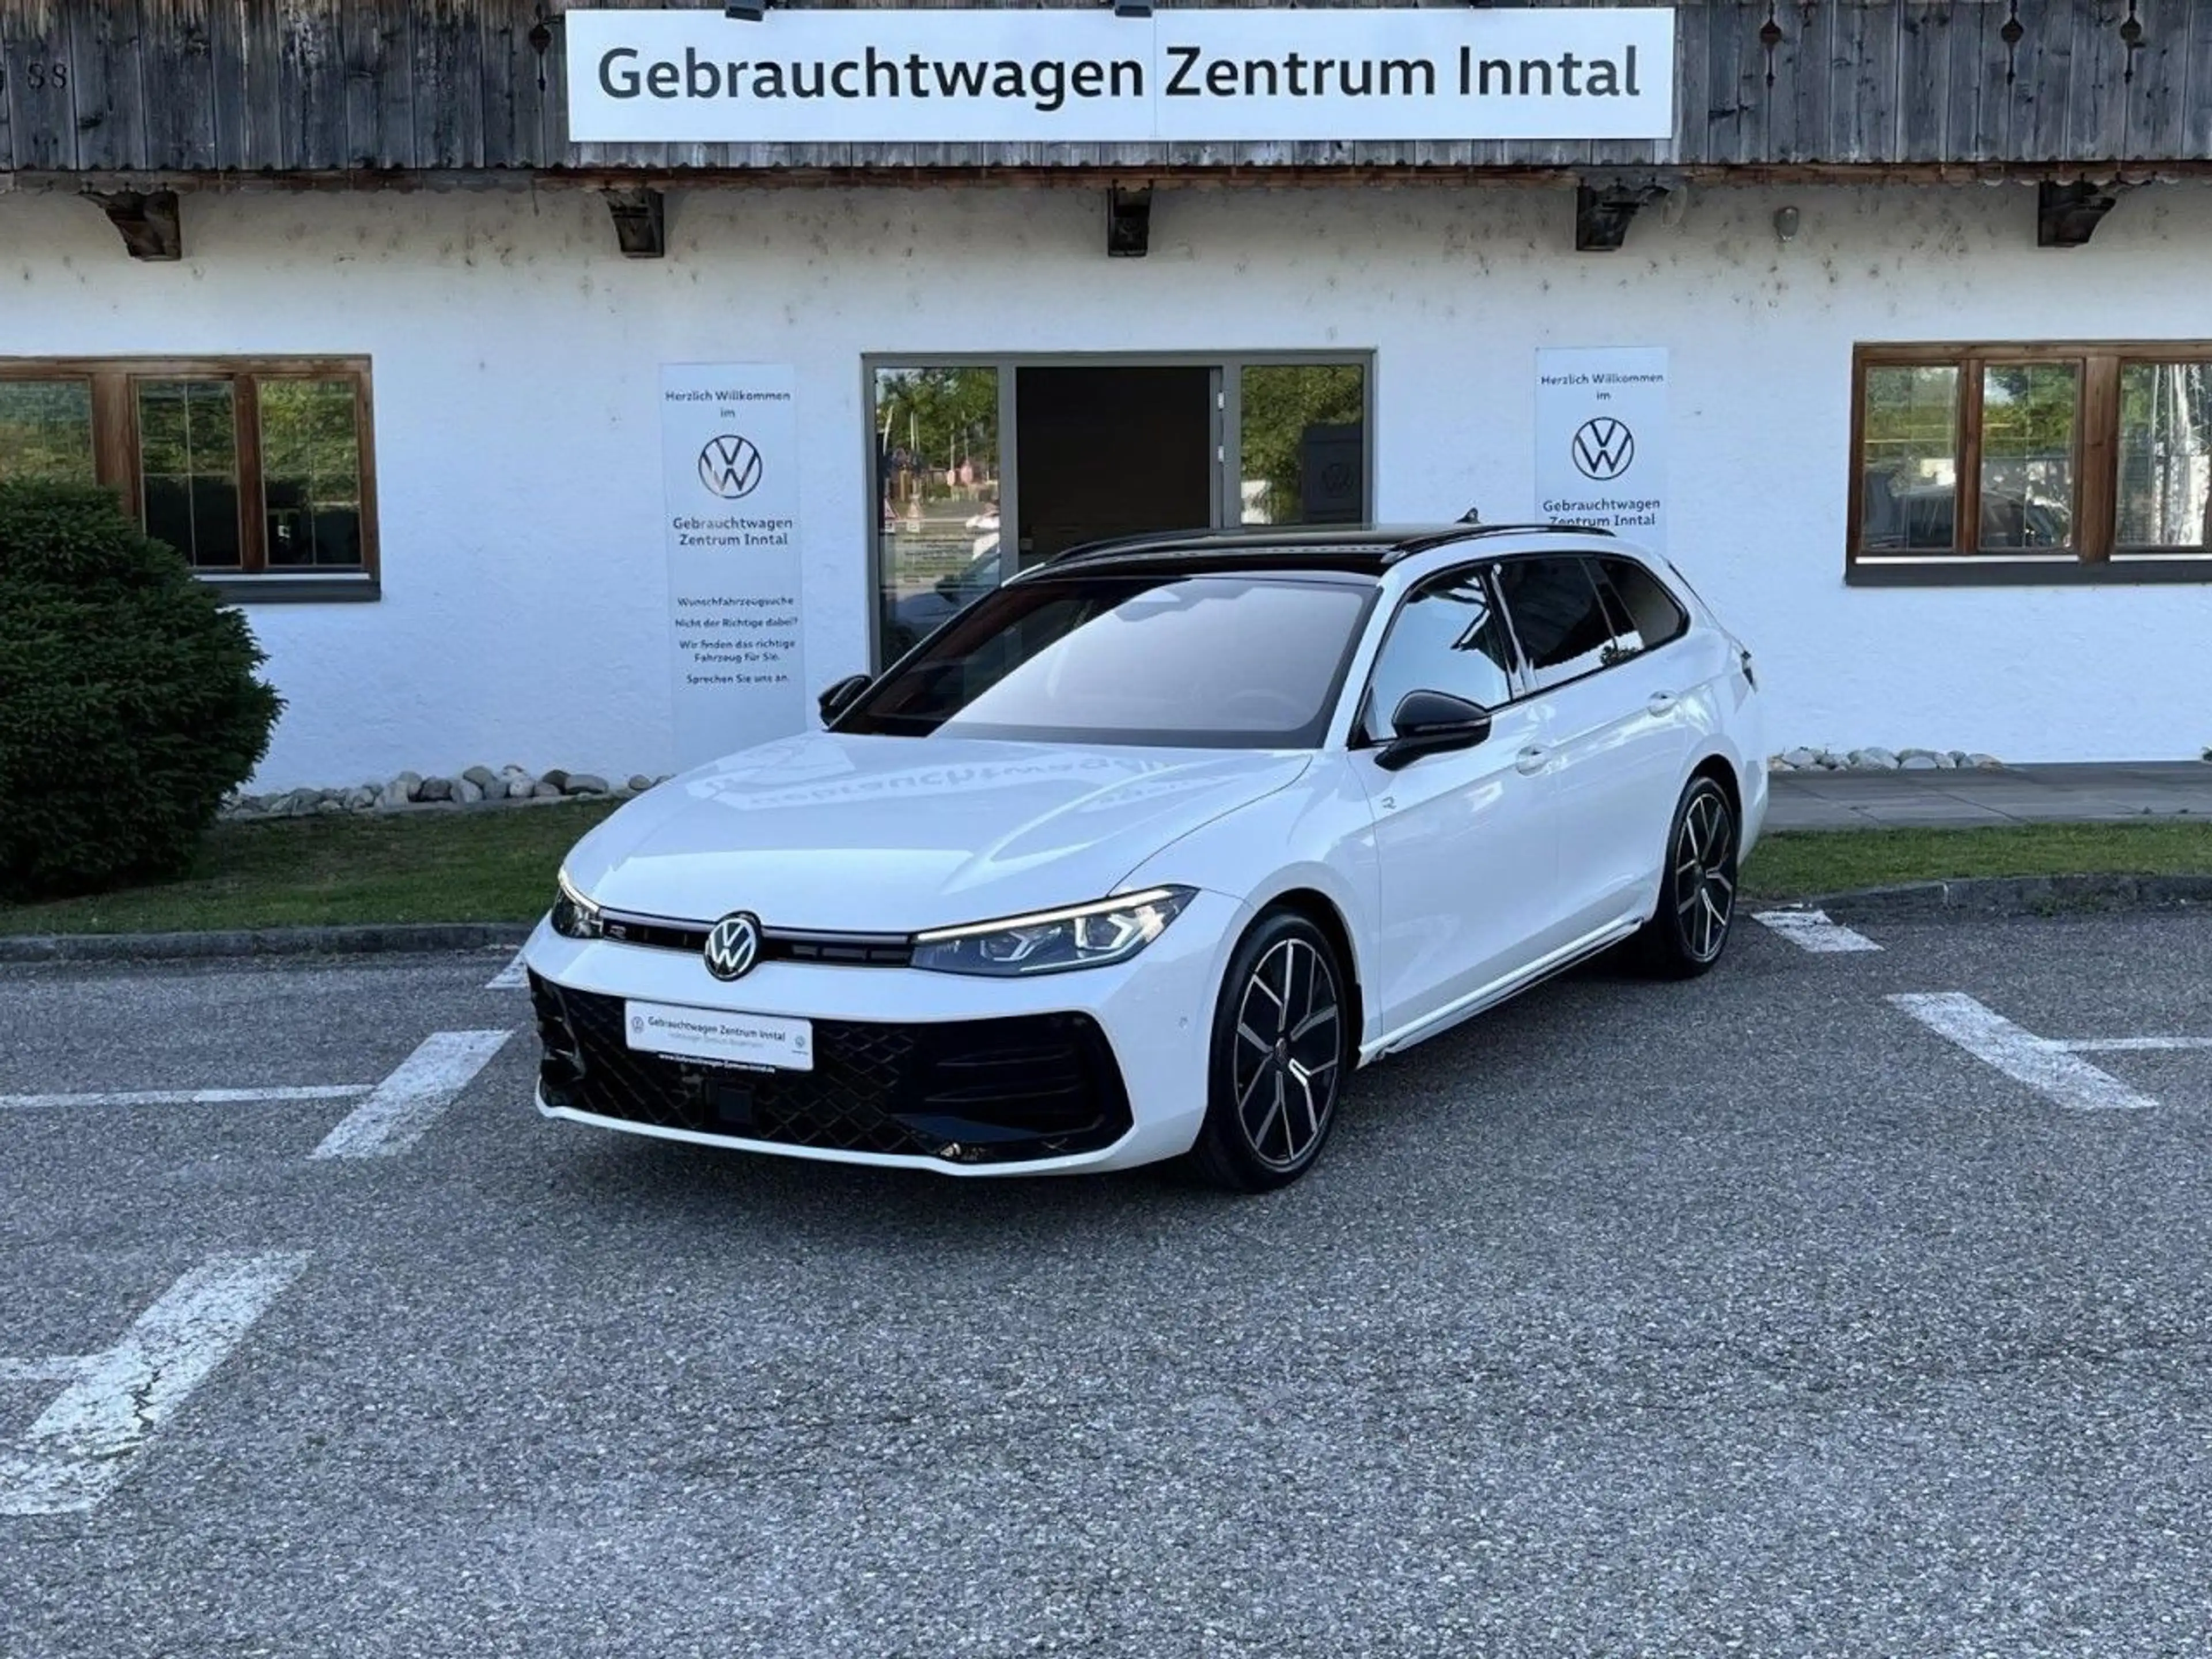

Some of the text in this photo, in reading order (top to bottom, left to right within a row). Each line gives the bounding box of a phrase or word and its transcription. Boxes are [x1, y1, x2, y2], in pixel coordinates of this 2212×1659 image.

[599, 45, 1640, 111] Gebrauchtwagen Zentrum Inntal
[1541, 373, 1663, 385] Herzlich Willkommen
[665, 390, 791, 402] Herzlich Willkommen
[1597, 391, 1611, 400] im
[721, 407, 735, 418] im
[1573, 416, 1634, 480] VW
[698, 434, 762, 499] VW
[1543, 498, 1660, 512] Gebrauchtwagen
[673, 517, 792, 531] Gebrauchtwagen
[1550, 513, 1655, 527] Zentrum Inntal
[680, 533, 787, 546] Zentrum Inntal
[703, 618, 720, 627] der
[735, 640, 753, 649] das
[756, 638, 795, 649] richtige
[695, 653, 742, 663] Fahrzeug
[736, 673, 751, 683] Sie
[707, 918, 756, 978] VW
[647, 1016, 718, 1035] Gebrauchtwagen
[721, 1024, 757, 1037] Zentrum
